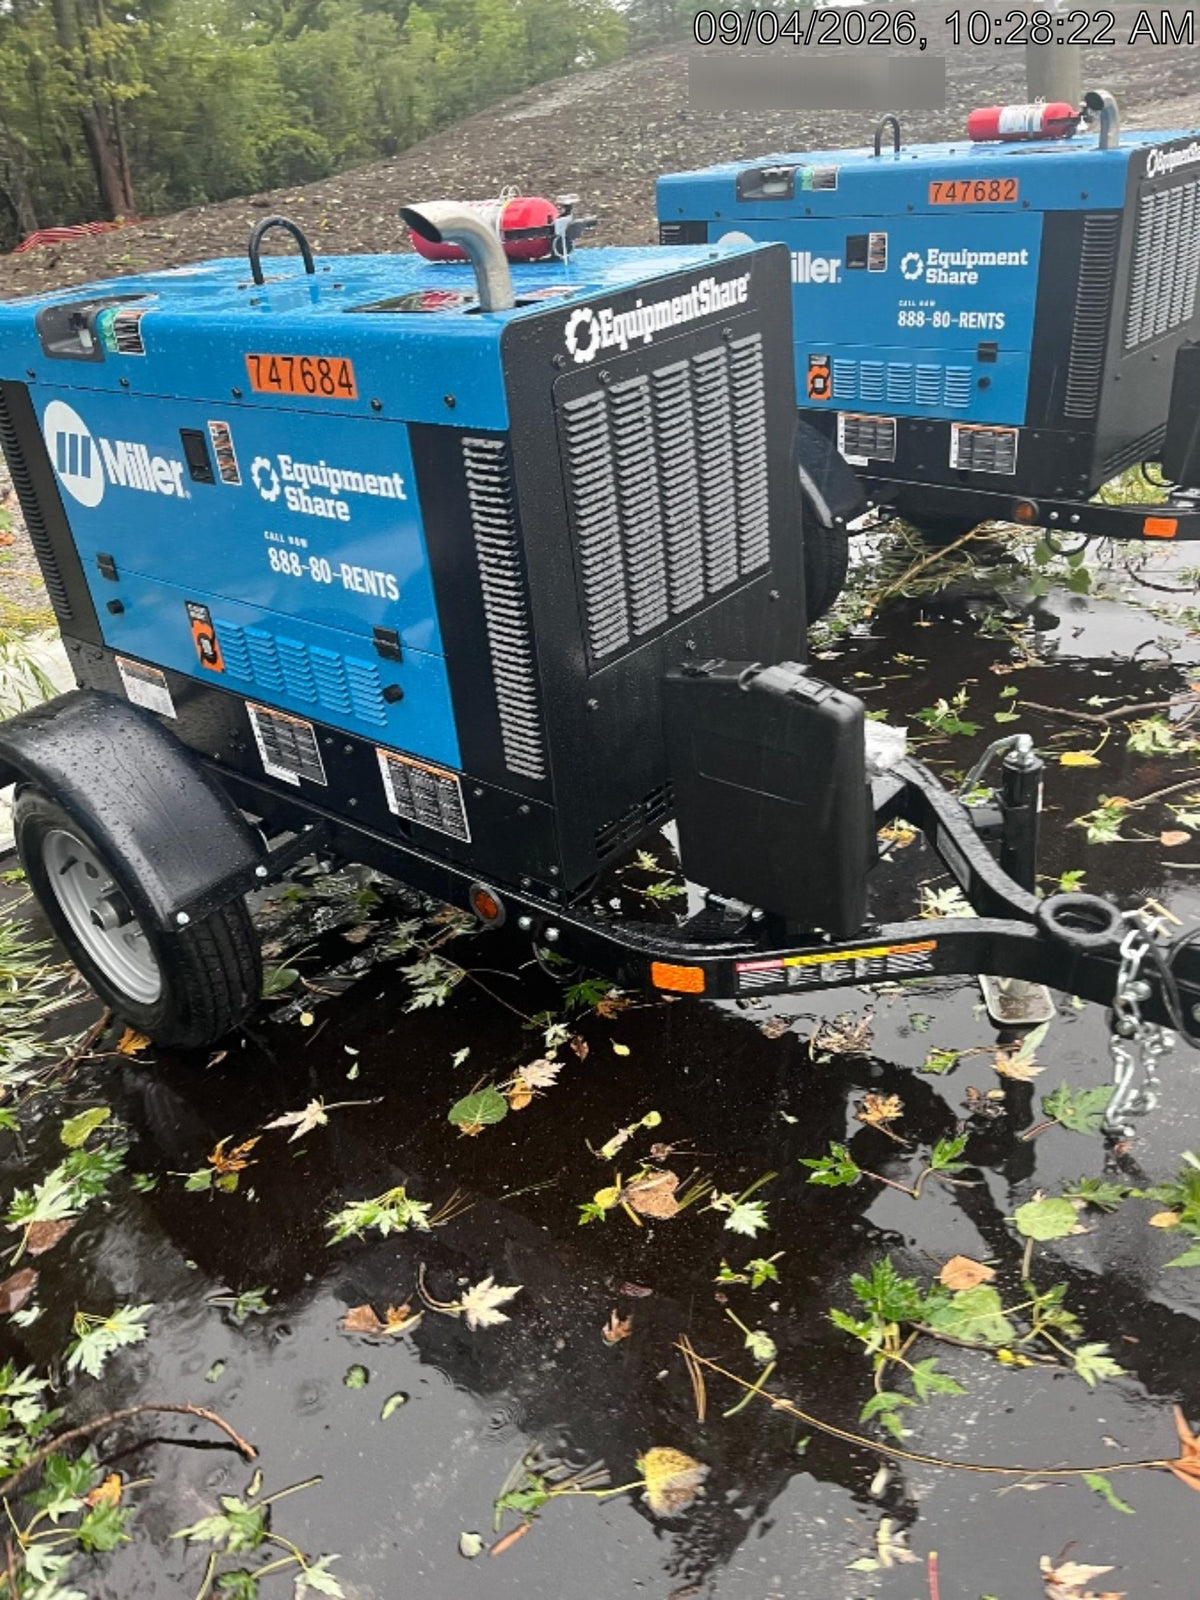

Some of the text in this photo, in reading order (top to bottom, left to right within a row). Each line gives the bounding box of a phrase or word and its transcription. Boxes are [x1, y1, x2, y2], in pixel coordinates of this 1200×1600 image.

[932, 179, 1016, 203] 747682
[791, 252, 842, 283] iller
[926, 248, 1028, 269] Equipment
[926, 268, 978, 284] Share
[598, 273, 749, 351] EquipmentShare
[898, 310, 1005, 329] 888-80-RENTS
[248, 355, 353, 396] 747684
[99, 437, 185, 498] Miller
[276, 454, 407, 500] Equipment
[284, 485, 351, 522] Share
[268, 547, 400, 600] 888-80-RENTS
